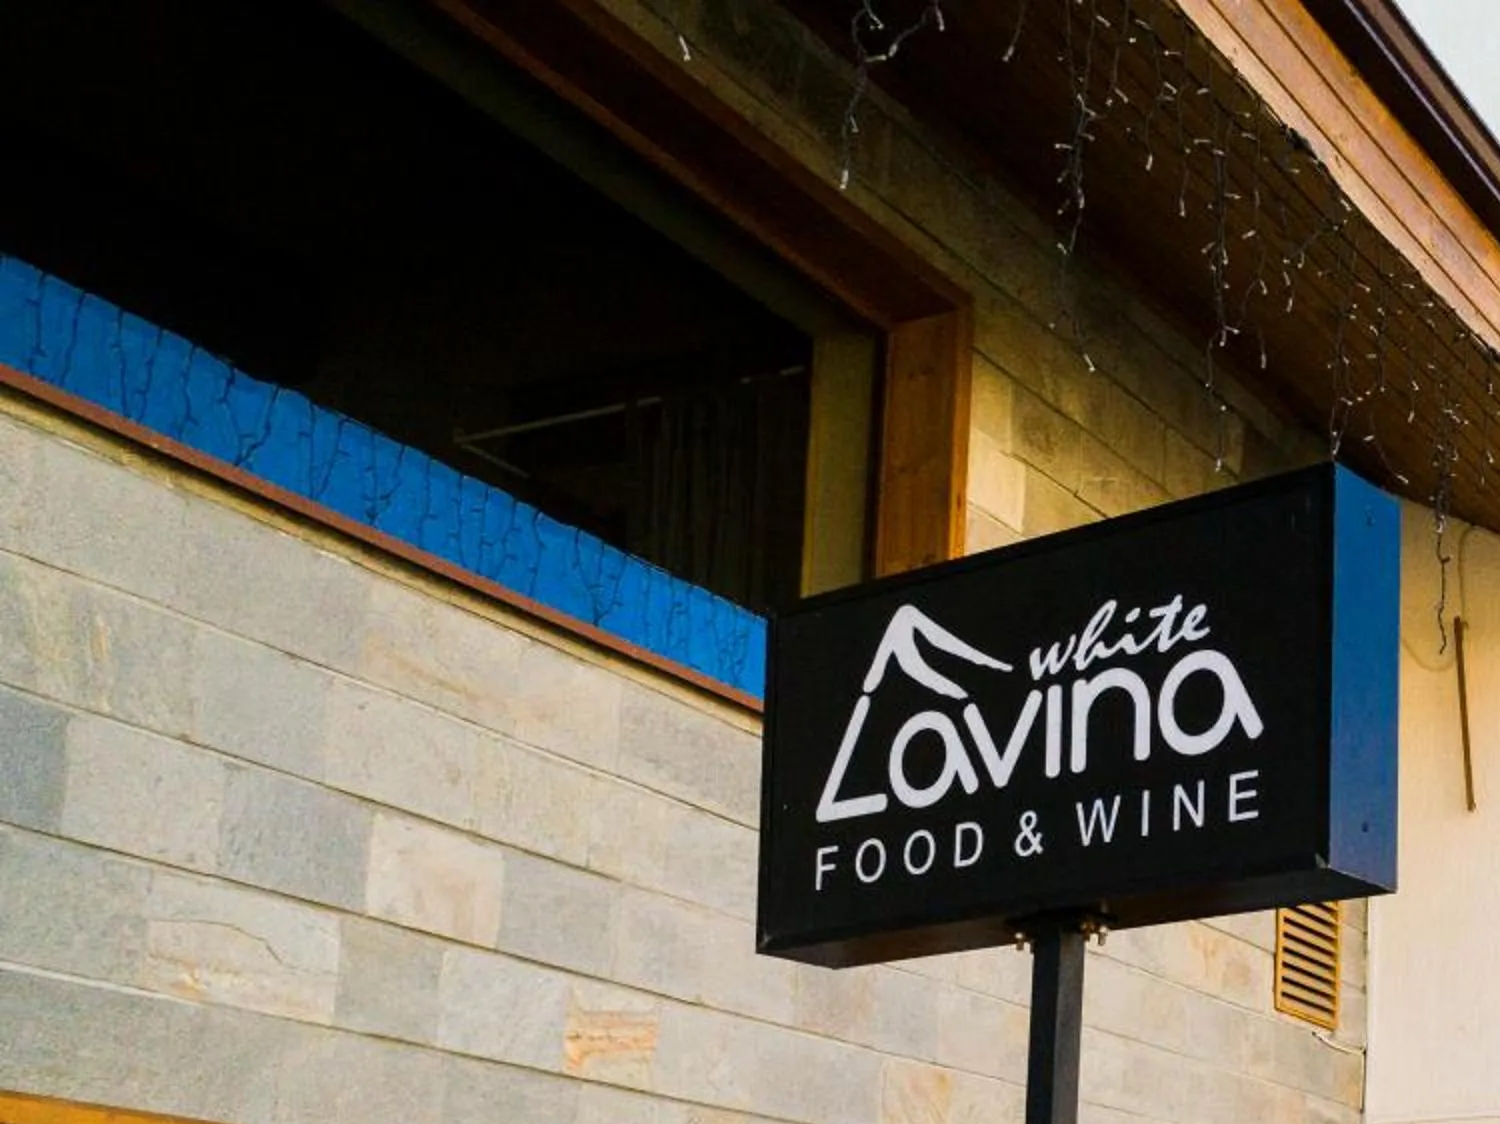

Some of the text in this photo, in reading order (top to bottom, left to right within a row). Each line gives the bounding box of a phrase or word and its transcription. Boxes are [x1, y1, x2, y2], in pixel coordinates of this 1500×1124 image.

[1029, 594, 1210, 681] white
[815, 649, 1264, 823] Lavina
[815, 769, 1259, 891] FOOD & WINE
